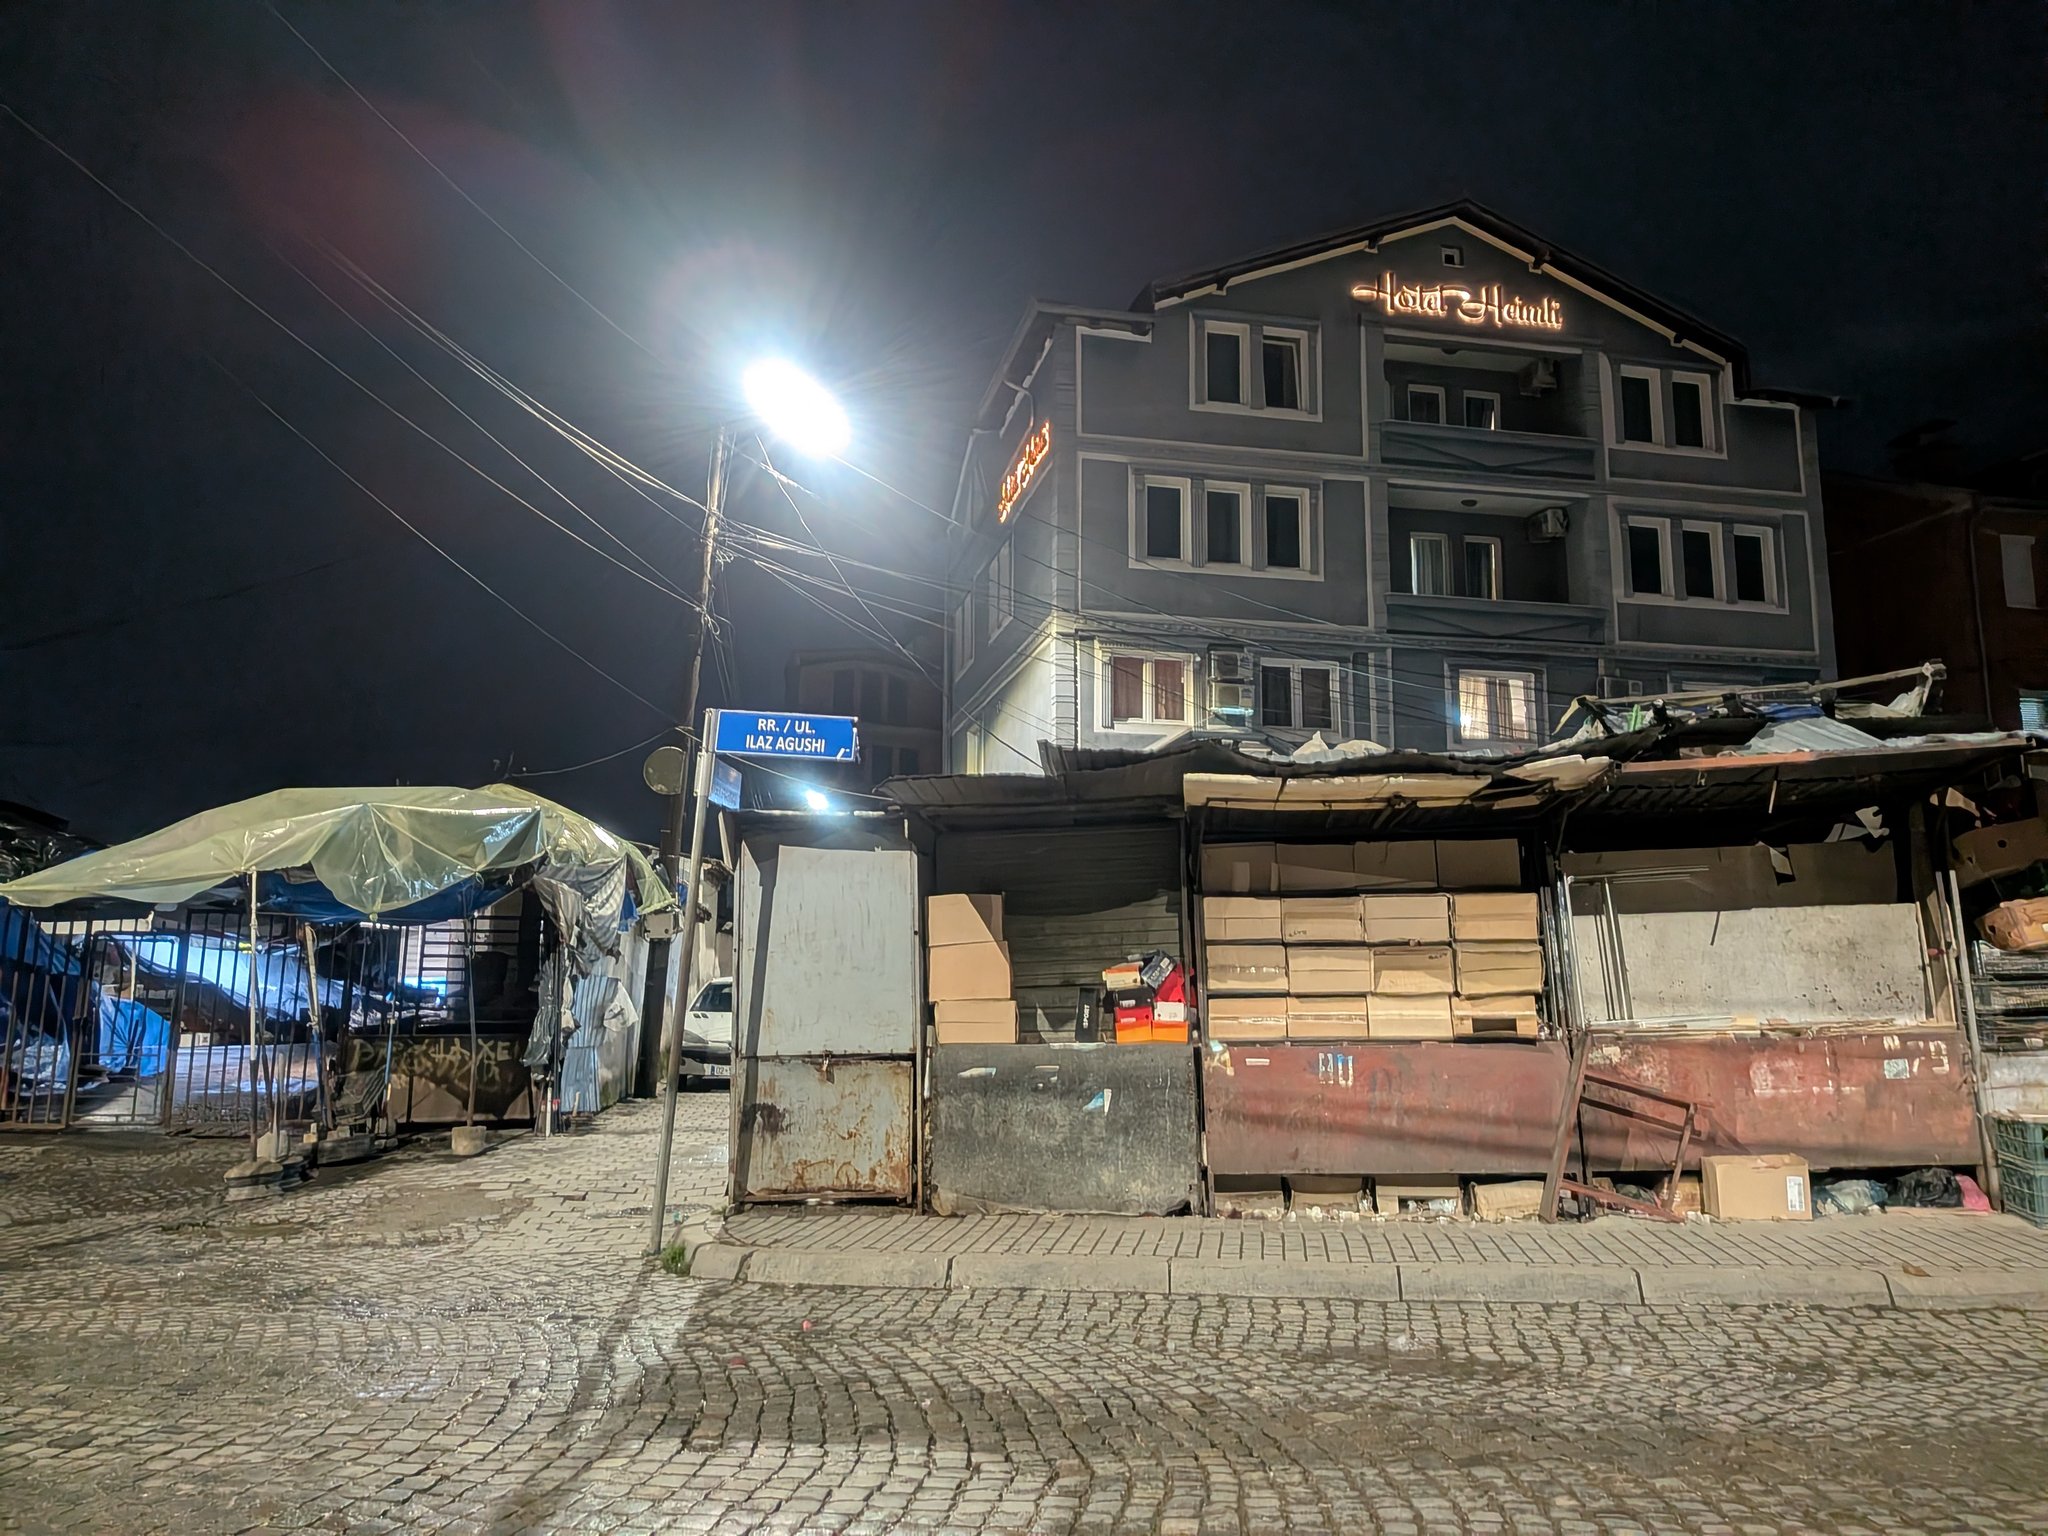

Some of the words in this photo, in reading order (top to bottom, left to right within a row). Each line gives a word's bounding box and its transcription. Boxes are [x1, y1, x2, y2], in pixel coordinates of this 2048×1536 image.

[1351, 270, 1471, 316] Hotel
[757, 718, 780, 732] RR.
[794, 720, 816, 734] UL.
[745, 734, 773, 751] ILAZ
[775, 736, 826, 753] AGUSHI
